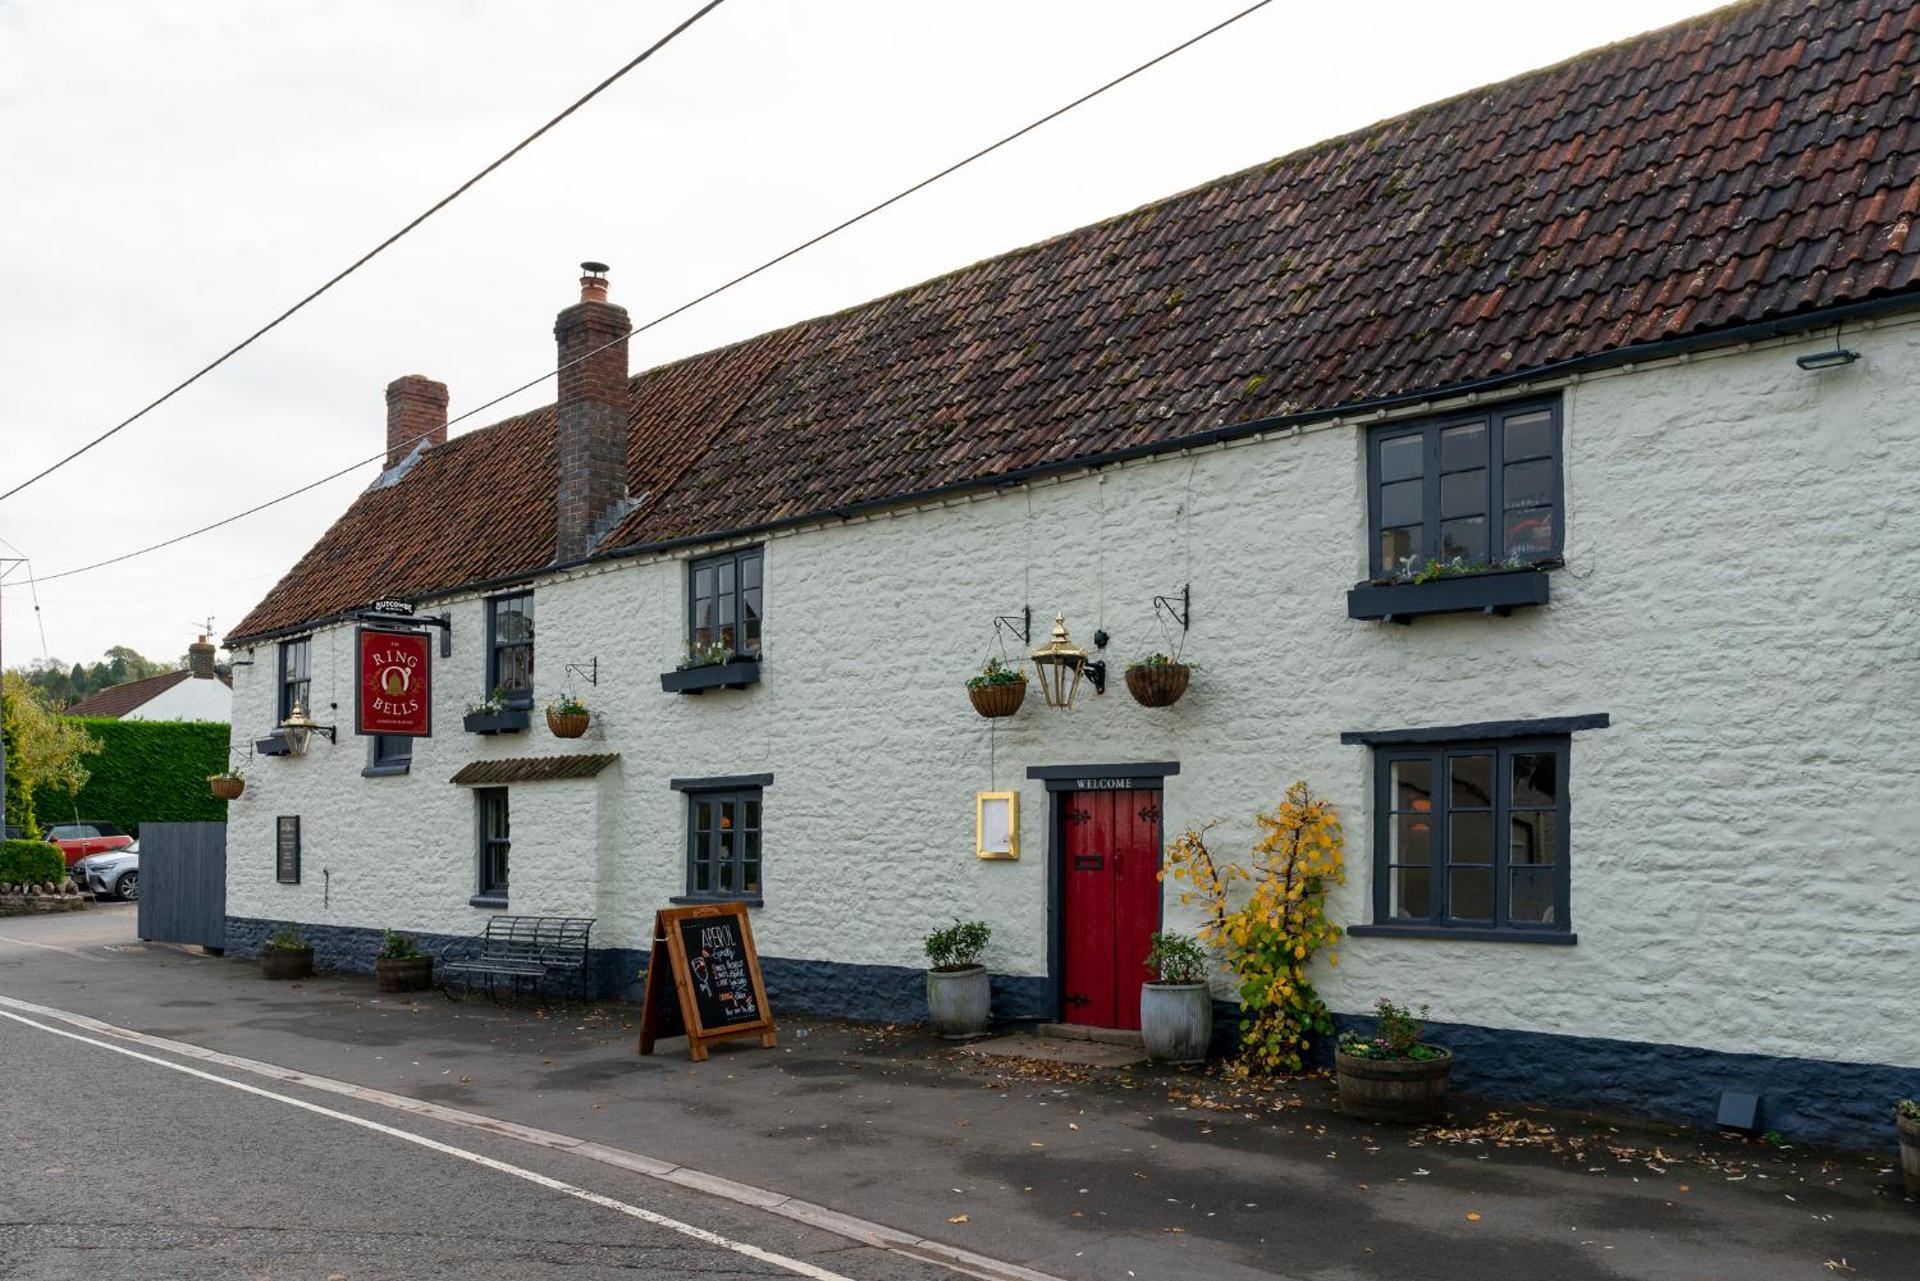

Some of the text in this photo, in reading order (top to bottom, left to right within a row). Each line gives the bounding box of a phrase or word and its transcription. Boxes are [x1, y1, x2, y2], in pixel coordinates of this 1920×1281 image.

[372, 650, 418, 668] RING
[372, 697, 419, 715] BELLS
[1076, 778, 1133, 789] WELCOME
[702, 924, 737, 948] APEROL
